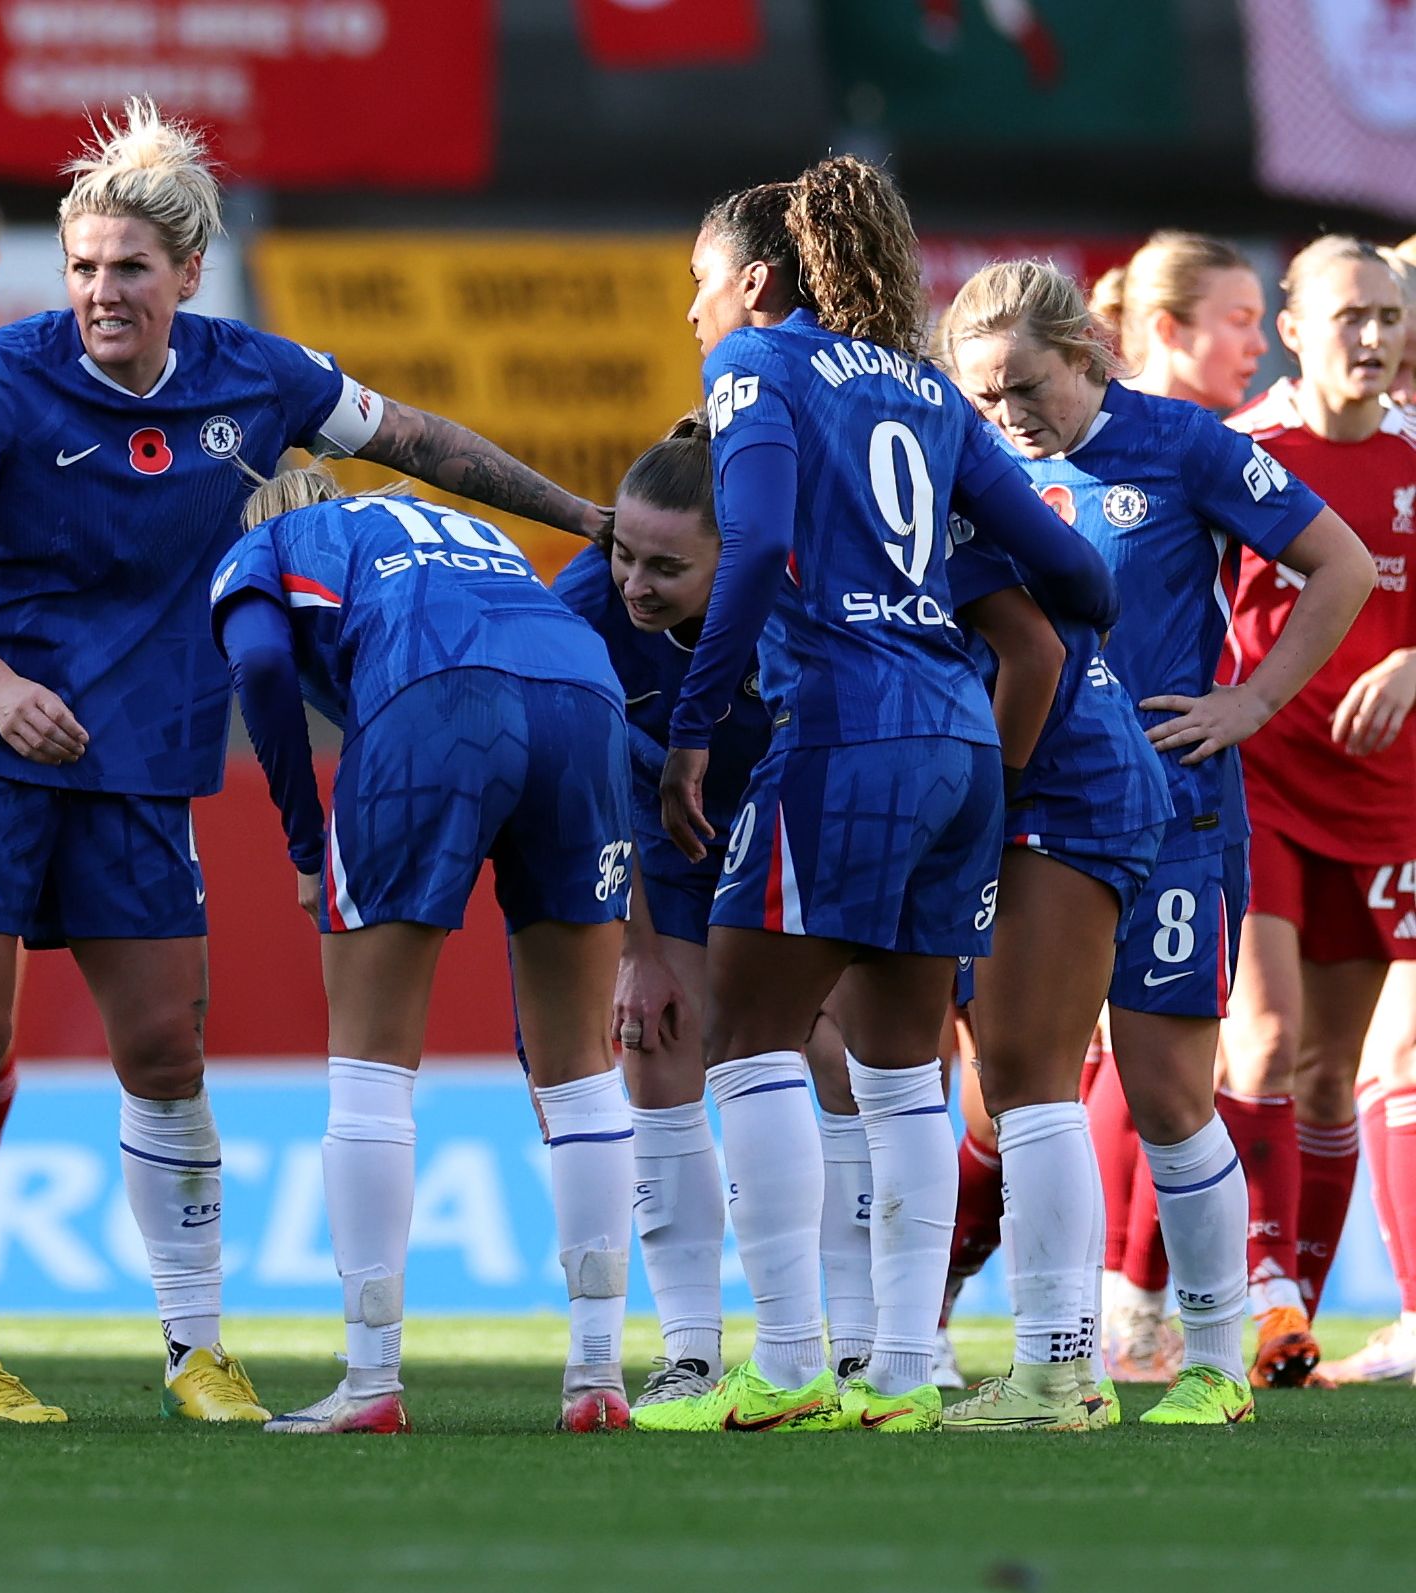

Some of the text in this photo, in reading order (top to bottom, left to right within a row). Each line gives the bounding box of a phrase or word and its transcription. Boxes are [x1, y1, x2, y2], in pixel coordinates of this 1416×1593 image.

[810, 341, 944, 407] MACARIO
[340, 496, 526, 561] 18
[869, 420, 934, 587] 9
[374, 549, 548, 590] SKOD
[842, 592, 958, 629] SKO
[724, 801, 756, 875] 9
[1152, 887, 1196, 963] 8
[182, 1201, 222, 1216] CFC
[1177, 1288, 1216, 1305] CFC
